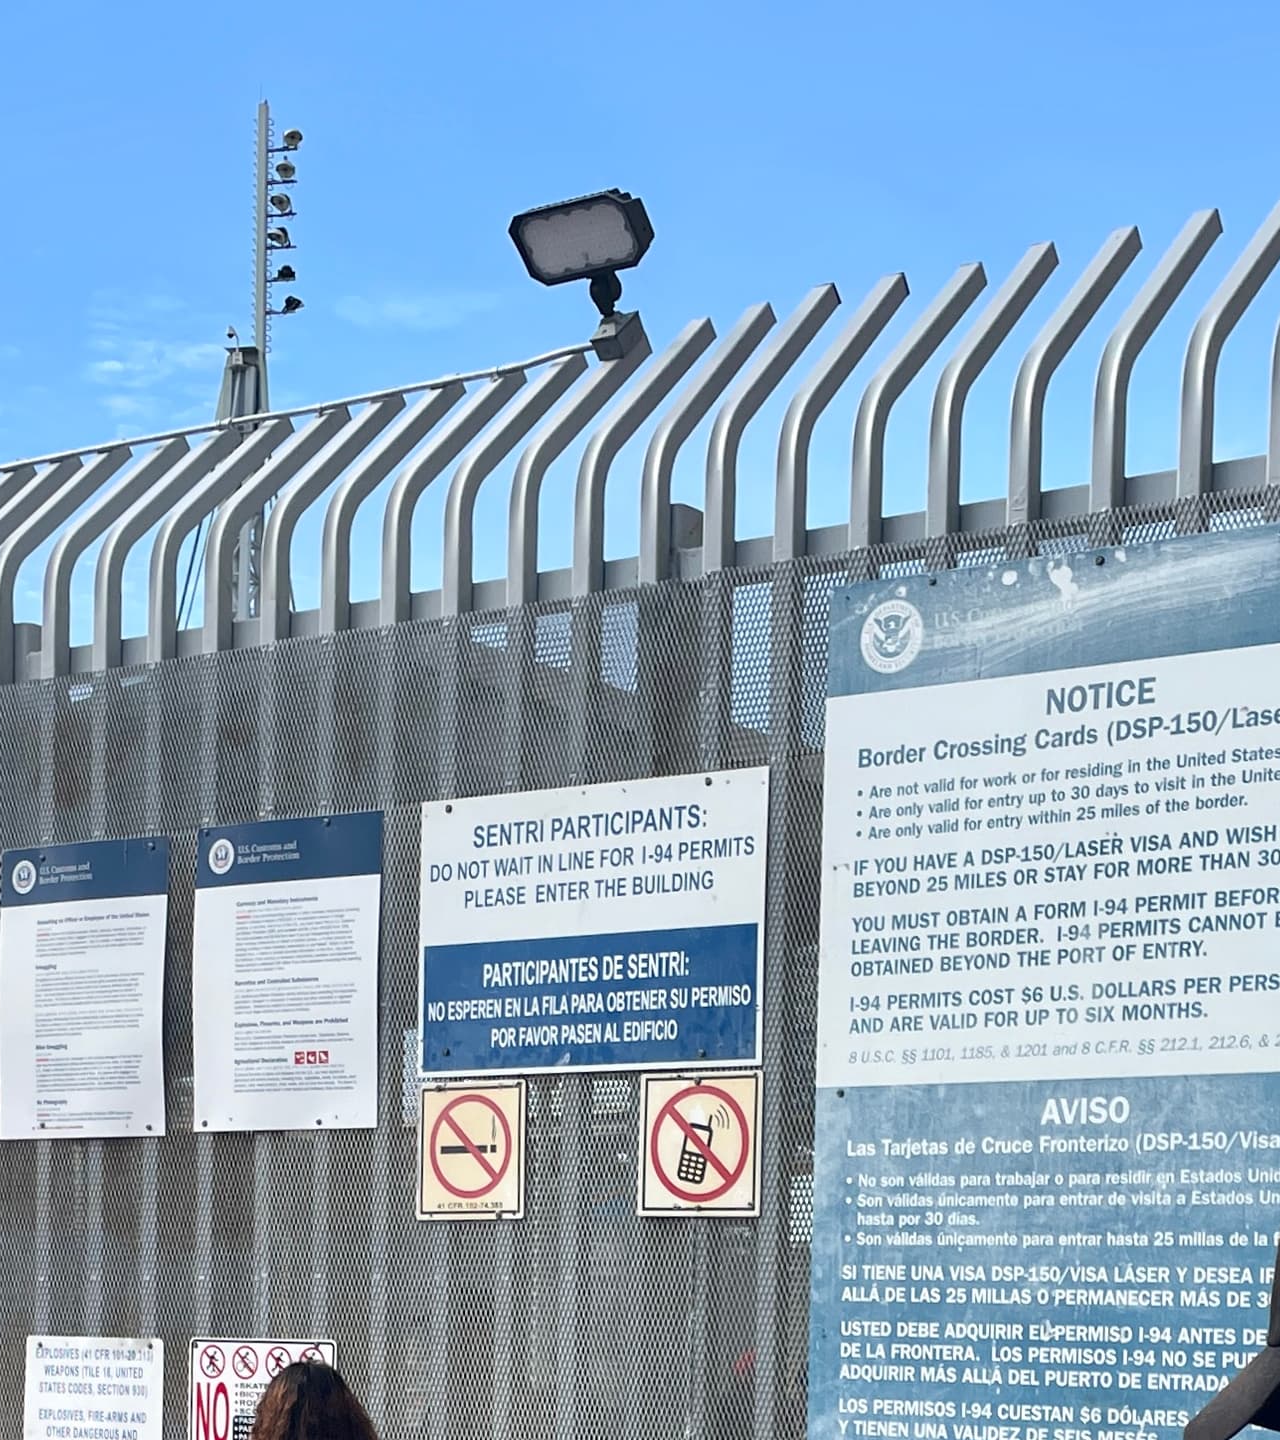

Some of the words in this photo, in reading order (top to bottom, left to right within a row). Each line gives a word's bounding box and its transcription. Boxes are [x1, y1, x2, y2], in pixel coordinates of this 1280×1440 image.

[1046, 677, 1156, 715] NOTICE
[858, 744, 926, 768] Border
[933, 734, 1026, 760] Crossing
[1035, 724, 1097, 749] Cards
[869, 785, 891, 798] Are
[897, 782, 918, 796] not
[924, 778, 954, 793] valid
[960, 776, 978, 789] for
[983, 772, 1016, 787] work
[1022, 773, 1036, 784] or
[1041, 768, 1059, 781] for
[1065, 762, 1122, 779] residing
[1128, 759, 1140, 773] in
[1146, 757, 1170, 771] the
[1176, 750, 1225, 768] United
[473, 819, 543, 848] SENTRI
[551, 804, 706, 841] PARTICIPANTS:
[430, 863, 452, 882] DO
[457, 860, 489, 880] NOT
[494, 856, 533, 877] WAIT
[538, 854, 552, 873] IN
[558, 850, 594, 871] LINE
[600, 847, 633, 867] FOR
[642, 843, 672, 864] I-94
[678, 835, 754, 861] PERMITS
[465, 886, 525, 908] PLEASE
[536, 881, 589, 903] ENTER
[594, 877, 626, 897] THE
[632, 870, 713, 895] BUILDING
[483, 956, 598, 987] PARTICIPANTES
[602, 955, 623, 980] DE
[627, 951, 689, 979] SENTRI:
[428, 1001, 445, 1021] NO
[448, 998, 501, 1020] ESPEREN
[504, 998, 521, 1017] EN
[524, 996, 540, 1016] LA
[542, 995, 568, 1015] FILA
[571, 992, 604, 1013] PARA
[606, 989, 667, 1012] OBTENER
[670, 988, 688, 1008] SU
[691, 984, 751, 1007] PERMISO
[491, 1027, 516, 1047] POR
[518, 1025, 558, 1046] FAVOR
[561, 1023, 601, 1044] PASEN
[603, 1022, 620, 1042] AL
[623, 1019, 677, 1041] EDIFICIO
[1040, 1096, 1129, 1125] AVISO
[847, 1140, 875, 1156] Las
[881, 1137, 948, 1158] Tarjetas
[954, 1137, 975, 1154] de
[981, 1136, 1033, 1153] Cruce
[1039, 1134, 1129, 1152] Fronterizo
[1135, 1132, 1280, 1155] (DSP-150/Visa
